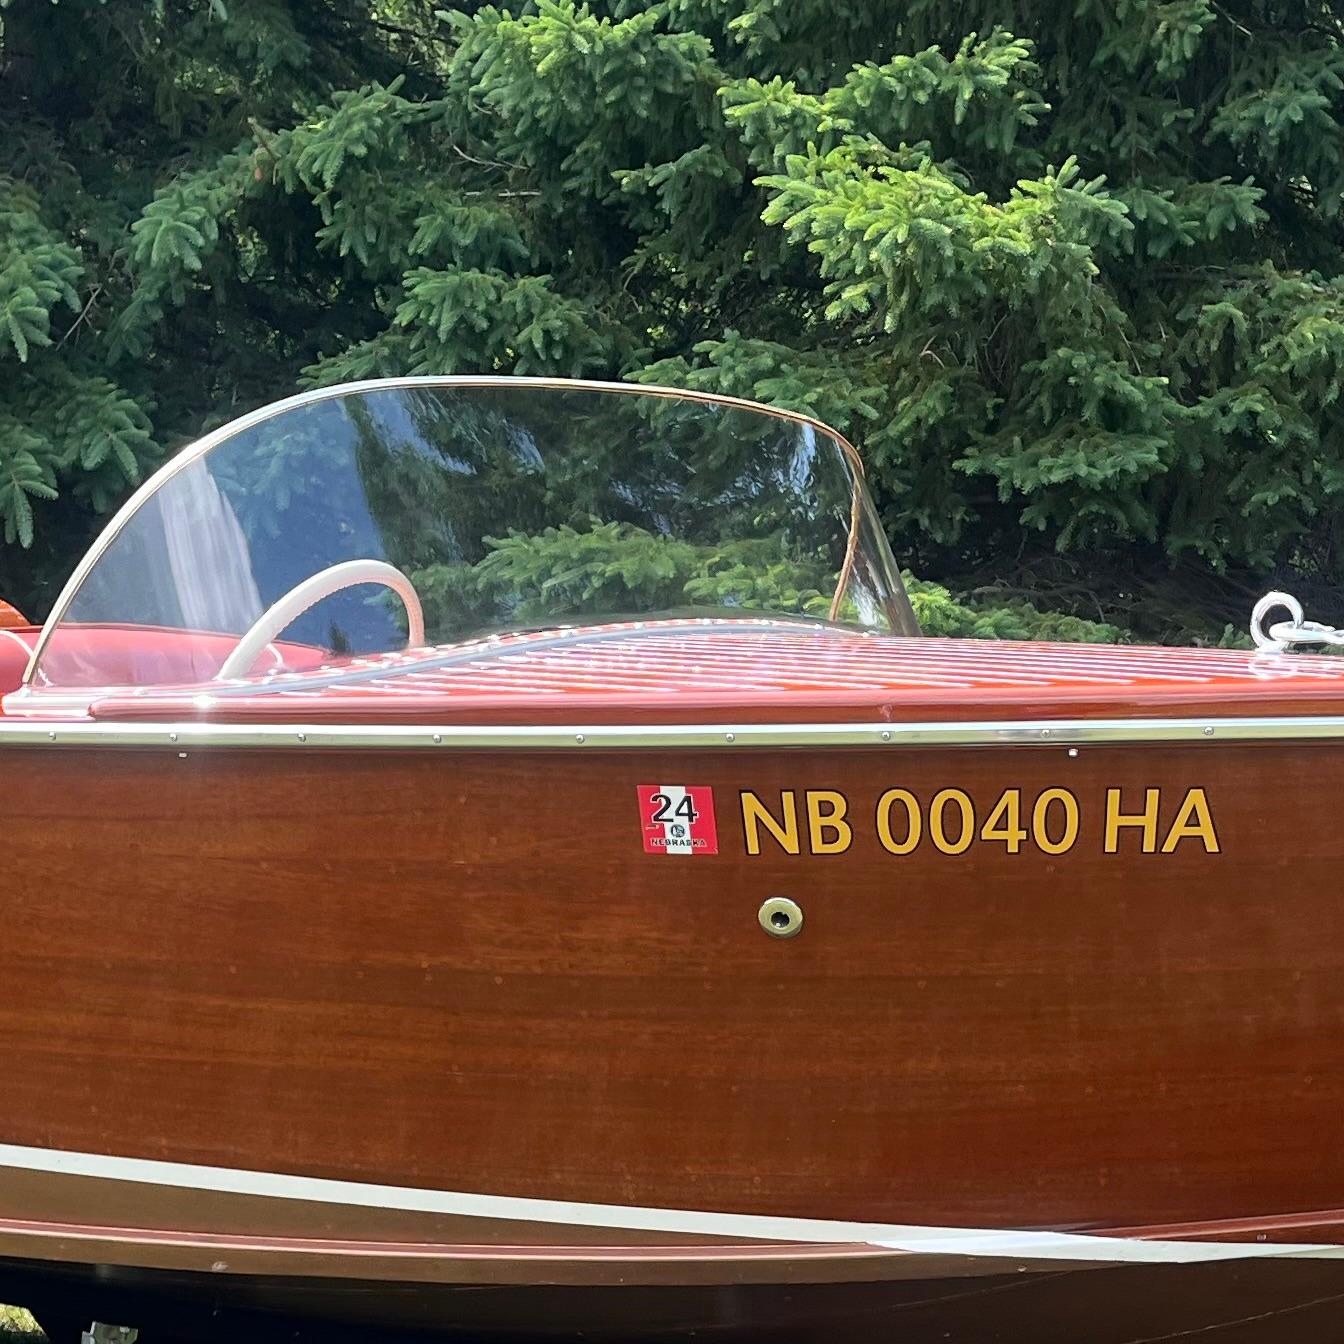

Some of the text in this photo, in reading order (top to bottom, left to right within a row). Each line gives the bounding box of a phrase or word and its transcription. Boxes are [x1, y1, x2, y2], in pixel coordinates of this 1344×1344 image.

[650, 793, 699, 824] 24
[739, 787, 1222, 856] NB 0040 HA
[650, 837, 708, 848] NEBRASKA
